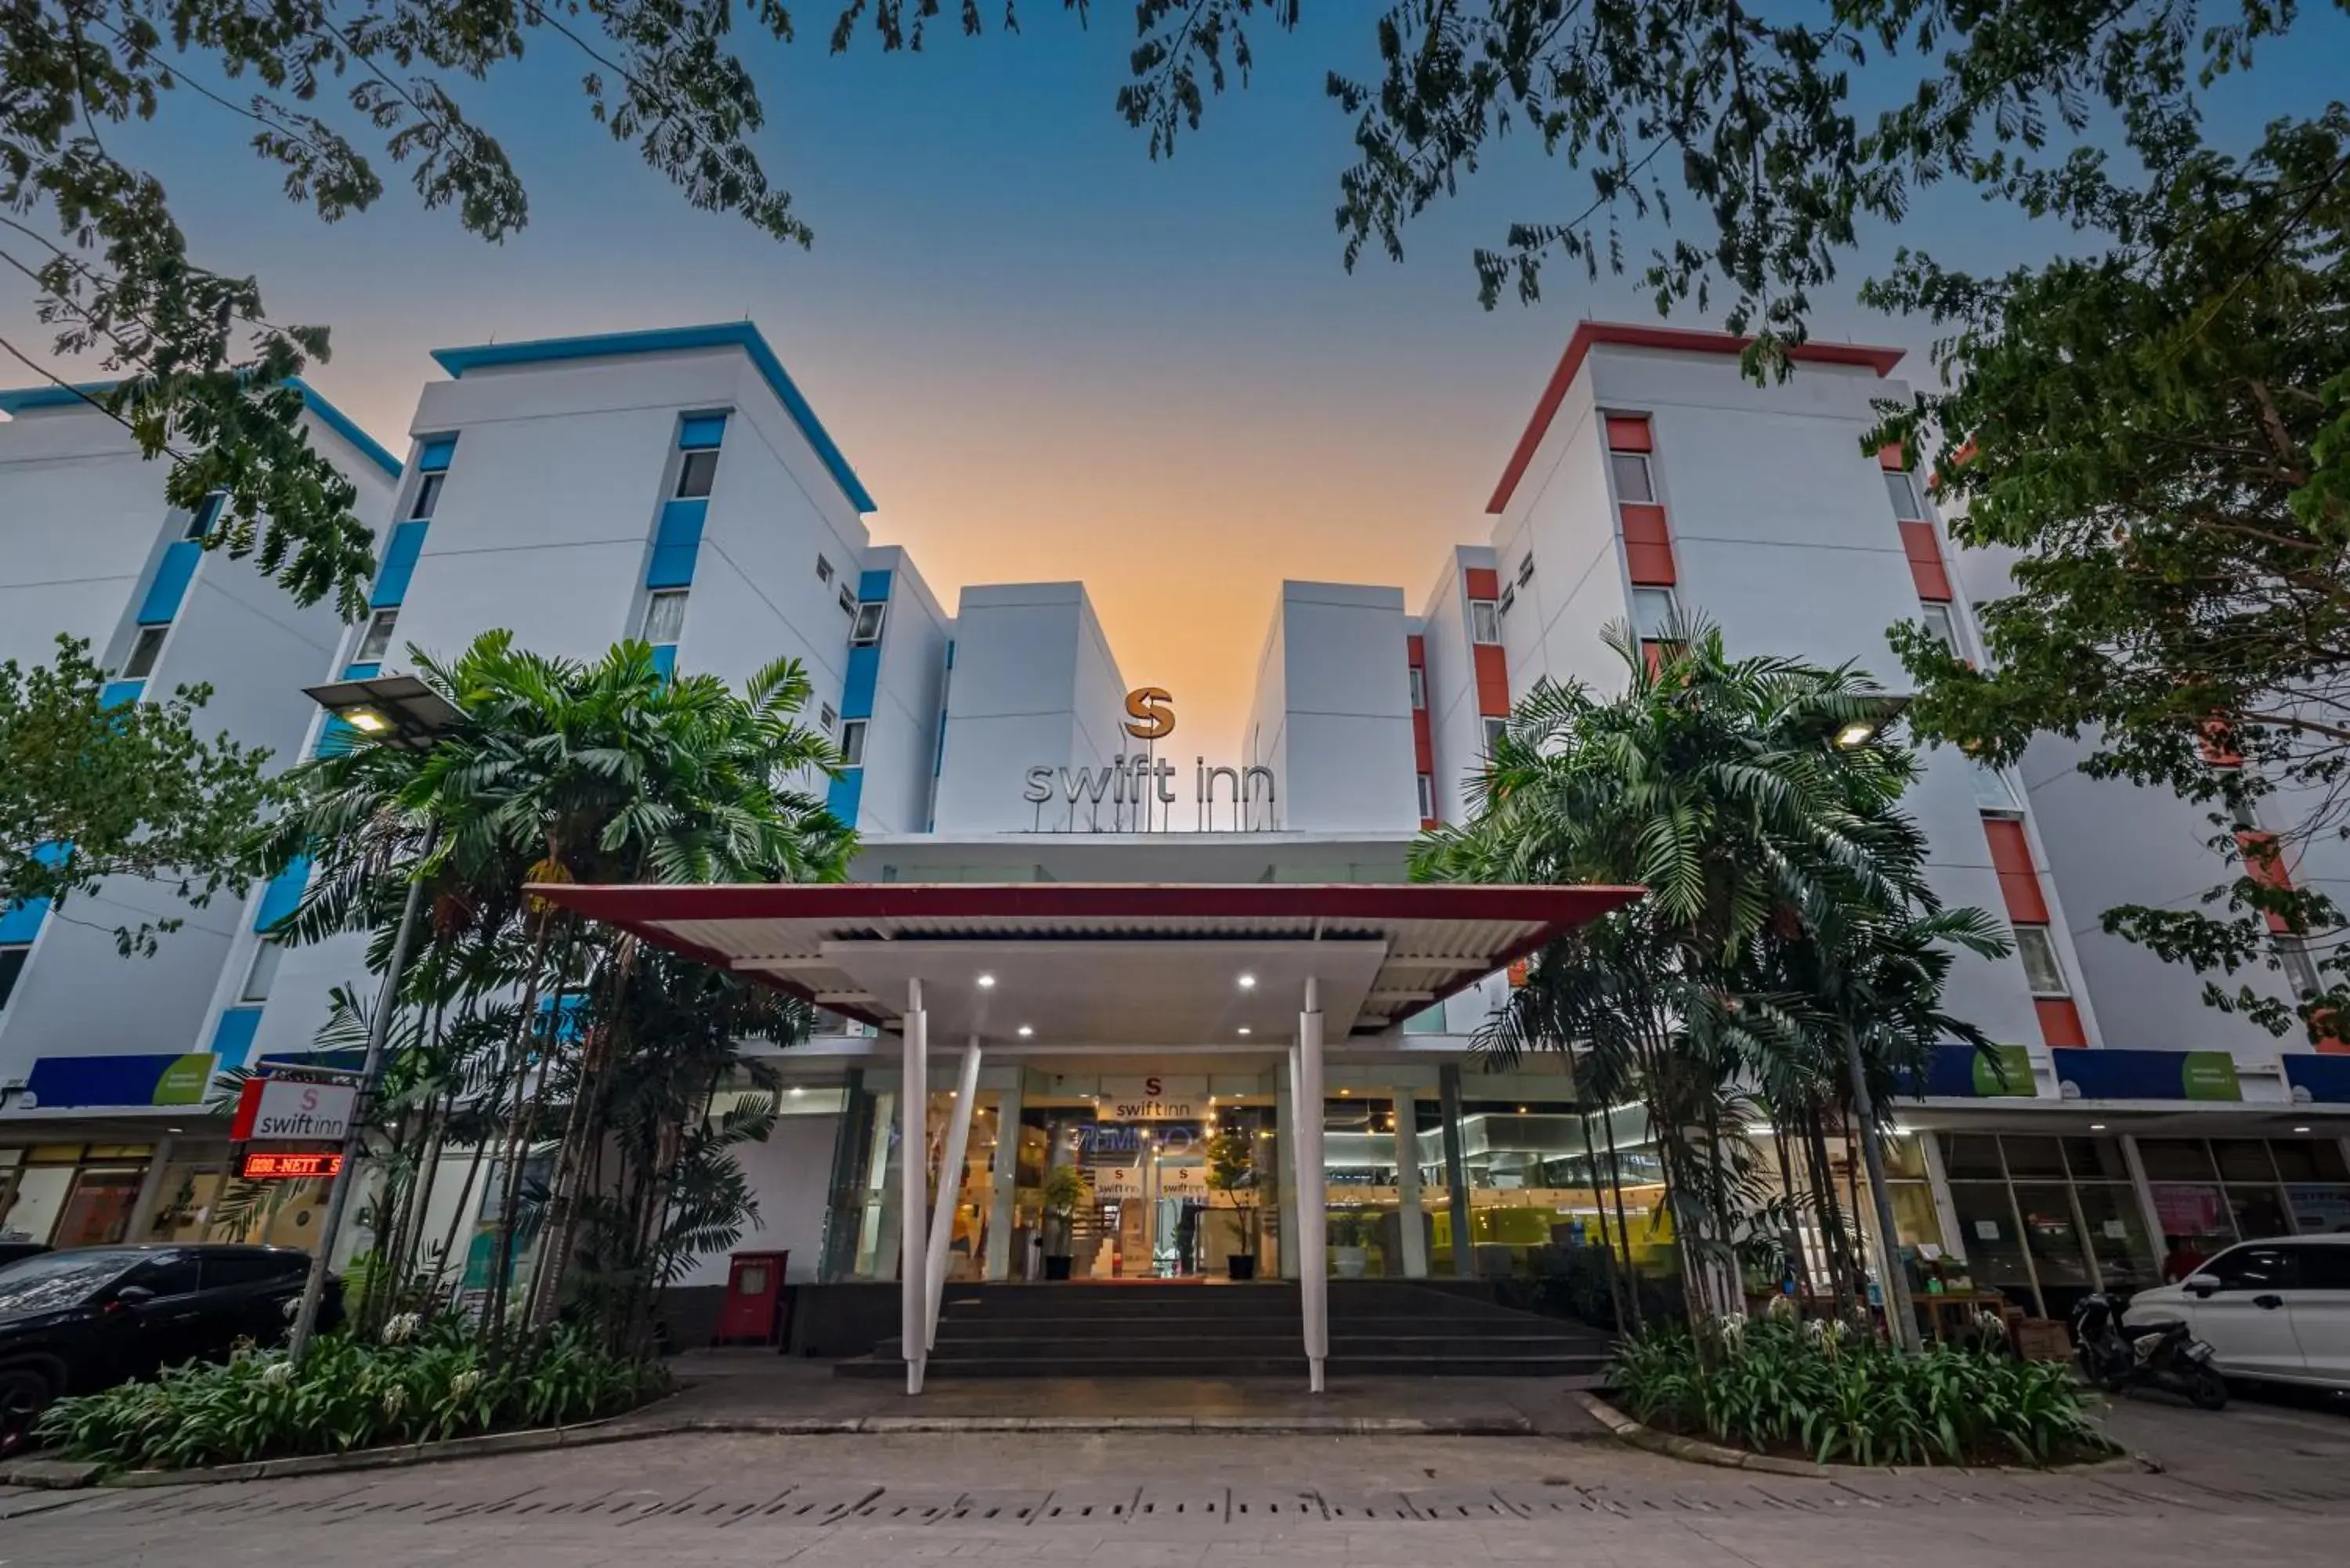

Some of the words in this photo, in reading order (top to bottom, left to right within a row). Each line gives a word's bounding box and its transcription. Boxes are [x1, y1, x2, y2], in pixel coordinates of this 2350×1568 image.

[1023, 753, 1176, 804] swift
[1196, 756, 1274, 803] inn
[1116, 1101, 1161, 1116] swift
[1165, 1104, 1190, 1116] inn
[260, 1114, 314, 1133] swift
[314, 1115, 343, 1135] inn
